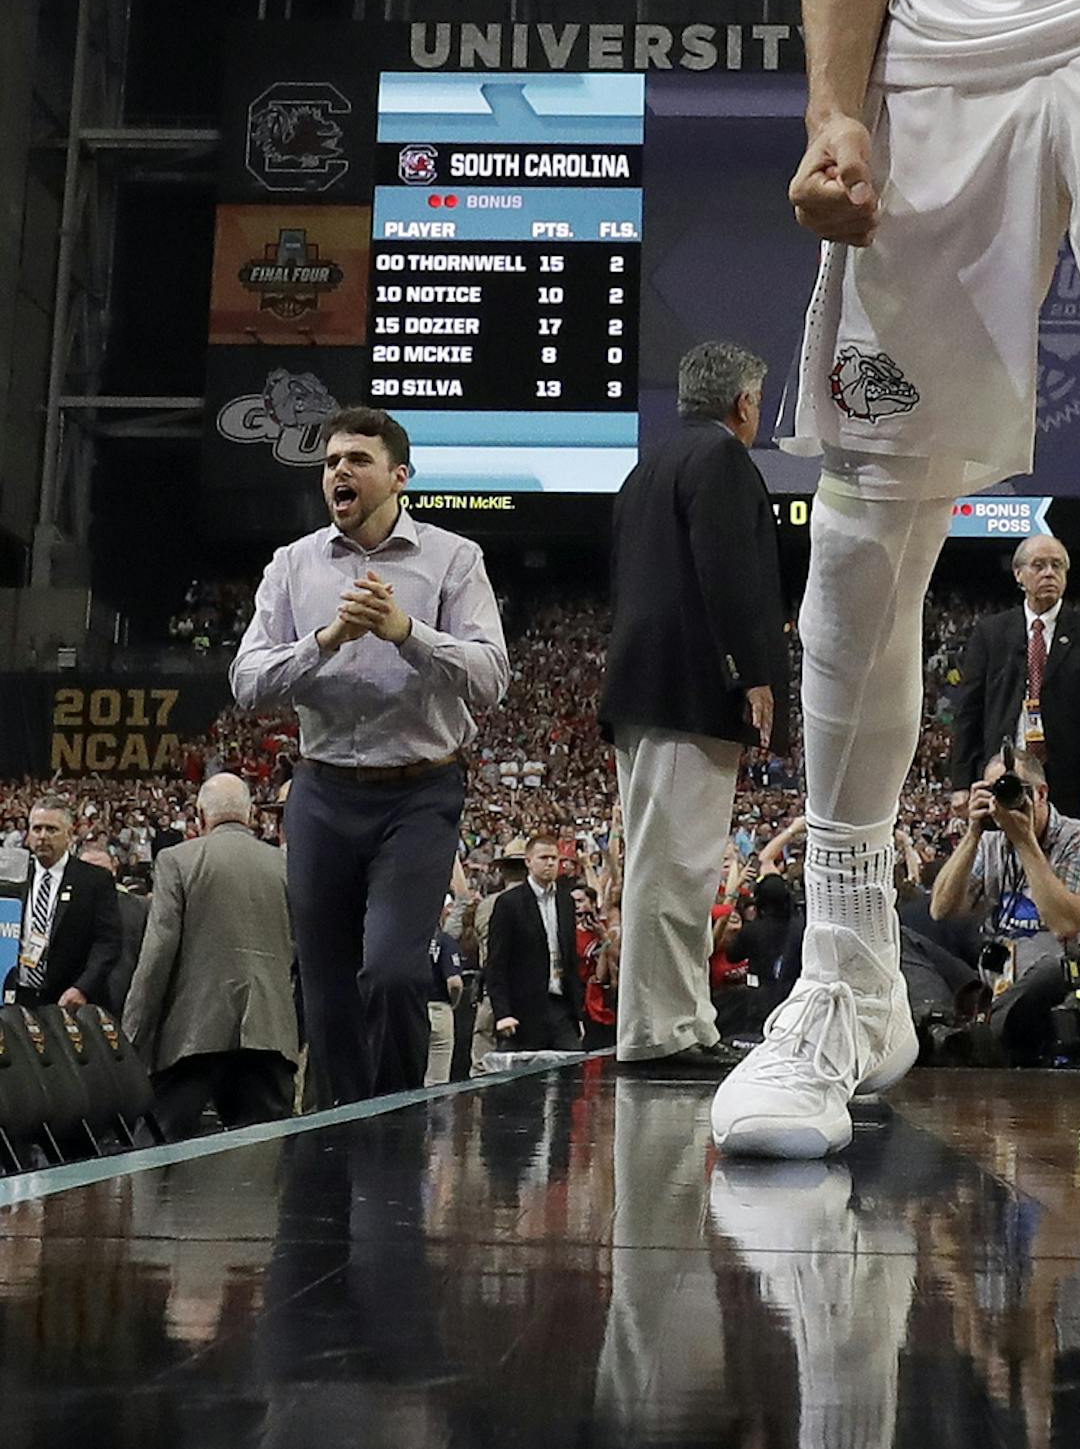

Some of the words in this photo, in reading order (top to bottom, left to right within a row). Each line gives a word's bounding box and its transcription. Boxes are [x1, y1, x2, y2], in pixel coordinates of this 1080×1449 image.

[410, 21, 805, 71] UNIVERSIT
[450, 153, 522, 177] SOUTH
[524, 154, 630, 178] CAROLINA
[466, 195, 523, 209] BONUS
[384, 221, 456, 238] PLAYER
[531, 222, 574, 238] PTS.
[600, 222, 638, 238] FLS.
[375, 254, 405, 271] 00
[407, 255, 527, 272] THORNWELL
[539, 255, 564, 272] 15
[609, 256, 624, 273] 2
[249, 266, 290, 282] FINAL
[291, 266, 330, 283] FOUR
[375, 286, 402, 302] 10
[406, 286, 482, 303] NOTICE
[538, 287, 564, 304] 10
[608, 288, 624, 304] 2
[374, 317, 400, 334] 15
[404, 317, 480, 334] DOZIER
[538, 318, 562, 335] 17
[608, 319, 623, 336] 2
[372, 345, 400, 362] 20
[403, 346, 473, 363] MCKIE
[541, 347, 557, 364] 8
[607, 347, 623, 364] 0
[371, 379, 399, 396] 30
[402, 379, 463, 396] SILVA
[536, 380, 562, 397] 13
[607, 381, 622, 398] 3
[415, 495, 468, 509] JUSTIN
[469, 495, 516, 510] McKIE.
[975, 503, 1031, 518] BONUS
[789, 500, 808, 525] 0
[987, 519, 1031, 533] POSS
[53, 688, 180, 726] 2017
[51, 732, 181, 771] NCAA
